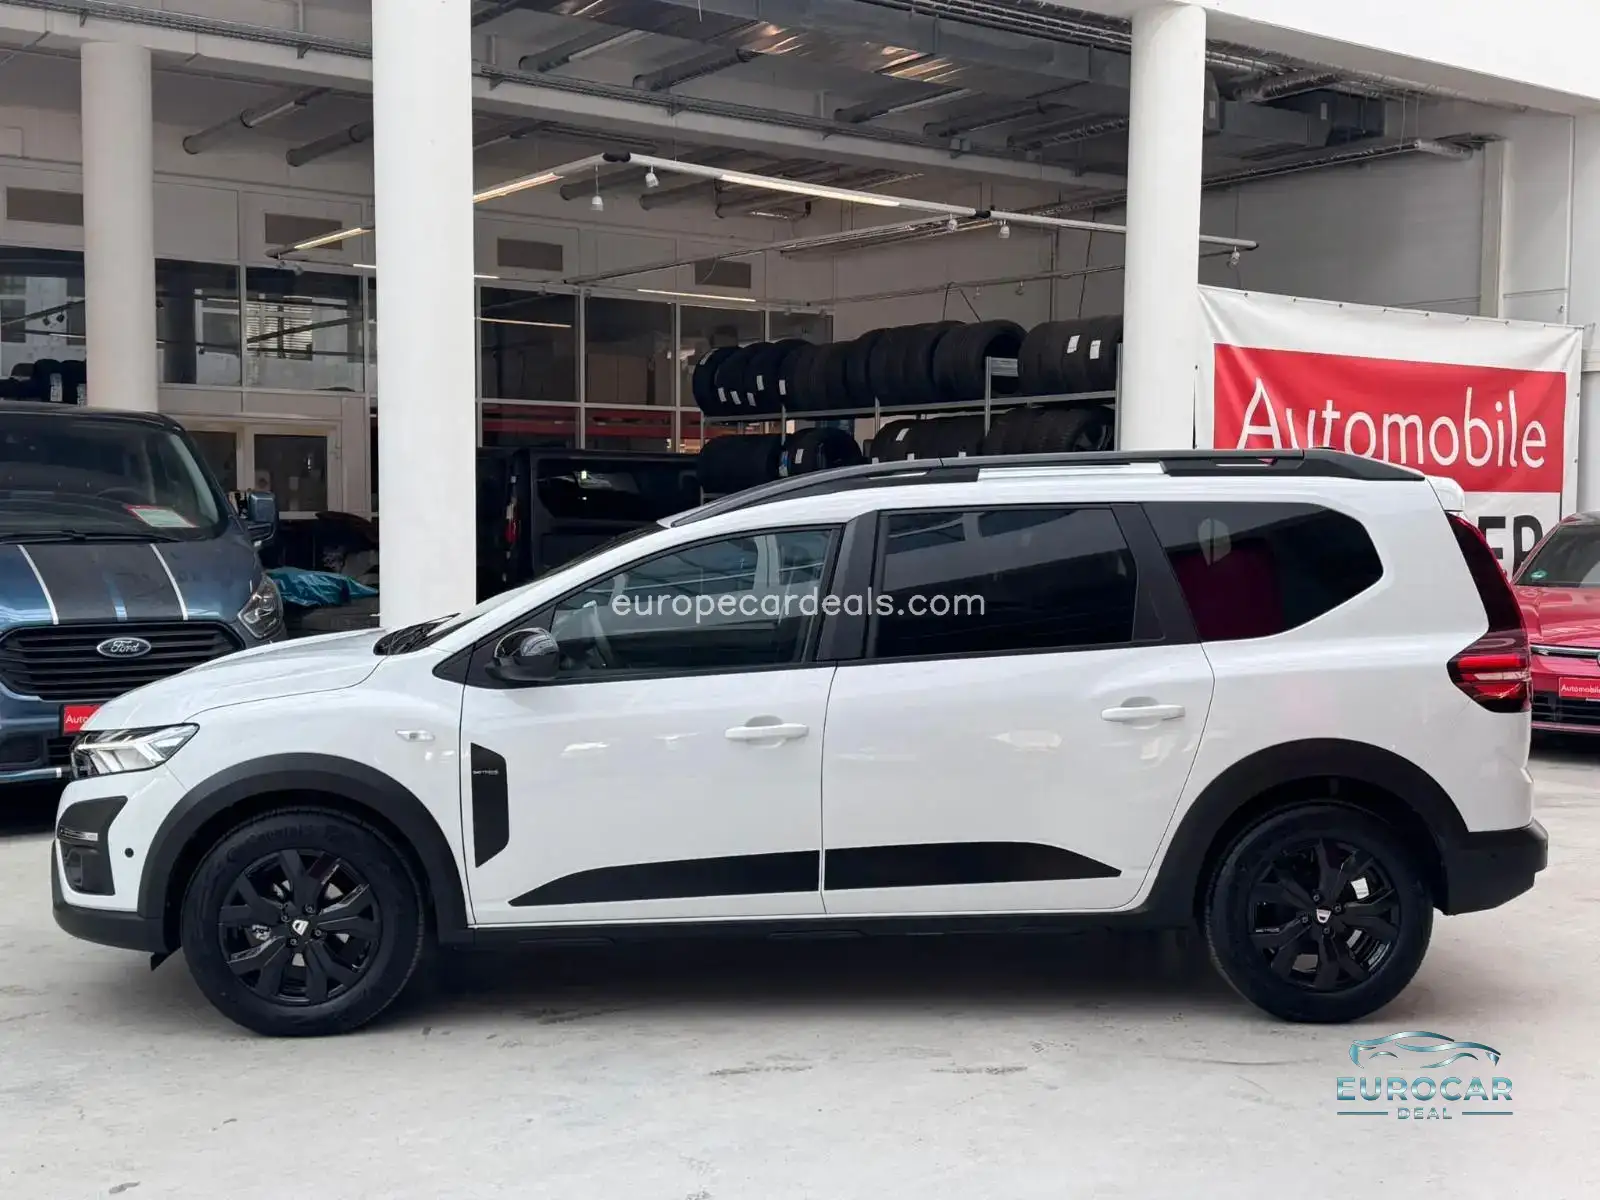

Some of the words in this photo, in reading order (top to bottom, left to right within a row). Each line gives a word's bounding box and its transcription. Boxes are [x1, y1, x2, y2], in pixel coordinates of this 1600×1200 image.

[1236, 376, 1547, 469] Automobile
[110, 640, 140, 653] Ford
[1560, 683, 1600, 695] Automobil
